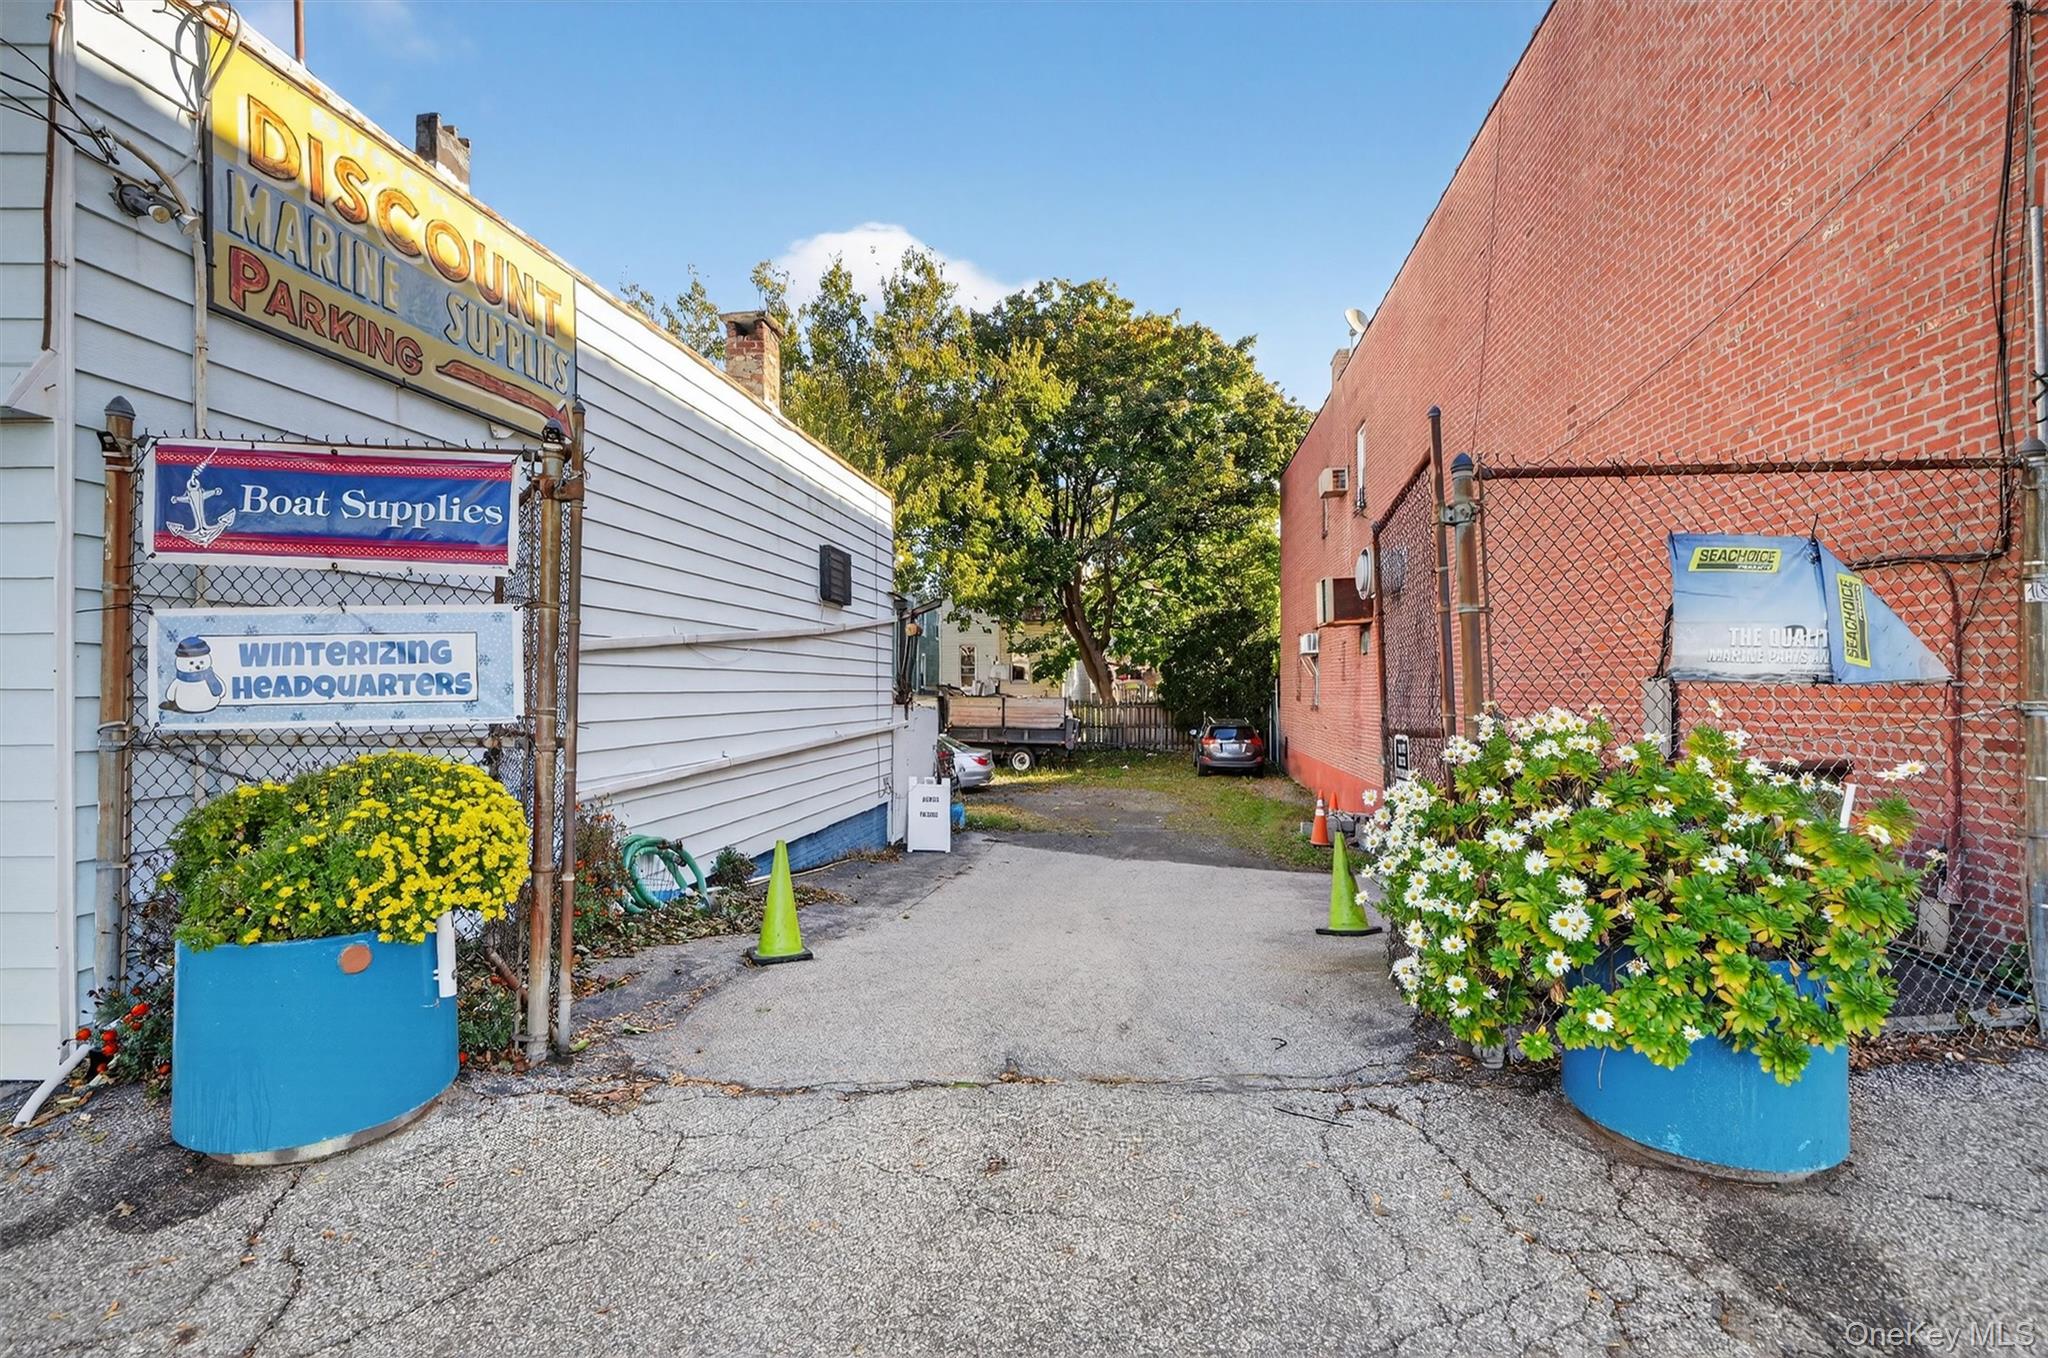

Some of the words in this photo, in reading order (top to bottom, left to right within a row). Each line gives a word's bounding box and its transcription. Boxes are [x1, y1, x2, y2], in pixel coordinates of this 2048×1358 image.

[247, 93, 563, 339] DISCOUNT
[227, 168, 401, 313] MARINE
[444, 291, 570, 396] SUPPLIES
[228, 245, 424, 377] PARKING
[239, 484, 331, 517] Boat
[341, 488, 504, 529] Supplies
[1699, 548, 1777, 564] SEACHOICE
[1728, 627, 1762, 648] THE
[1839, 578, 1860, 659] SEACHOICE
[1706, 648, 1765, 664] MARINE
[1769, 649, 1808, 665] PARTS
